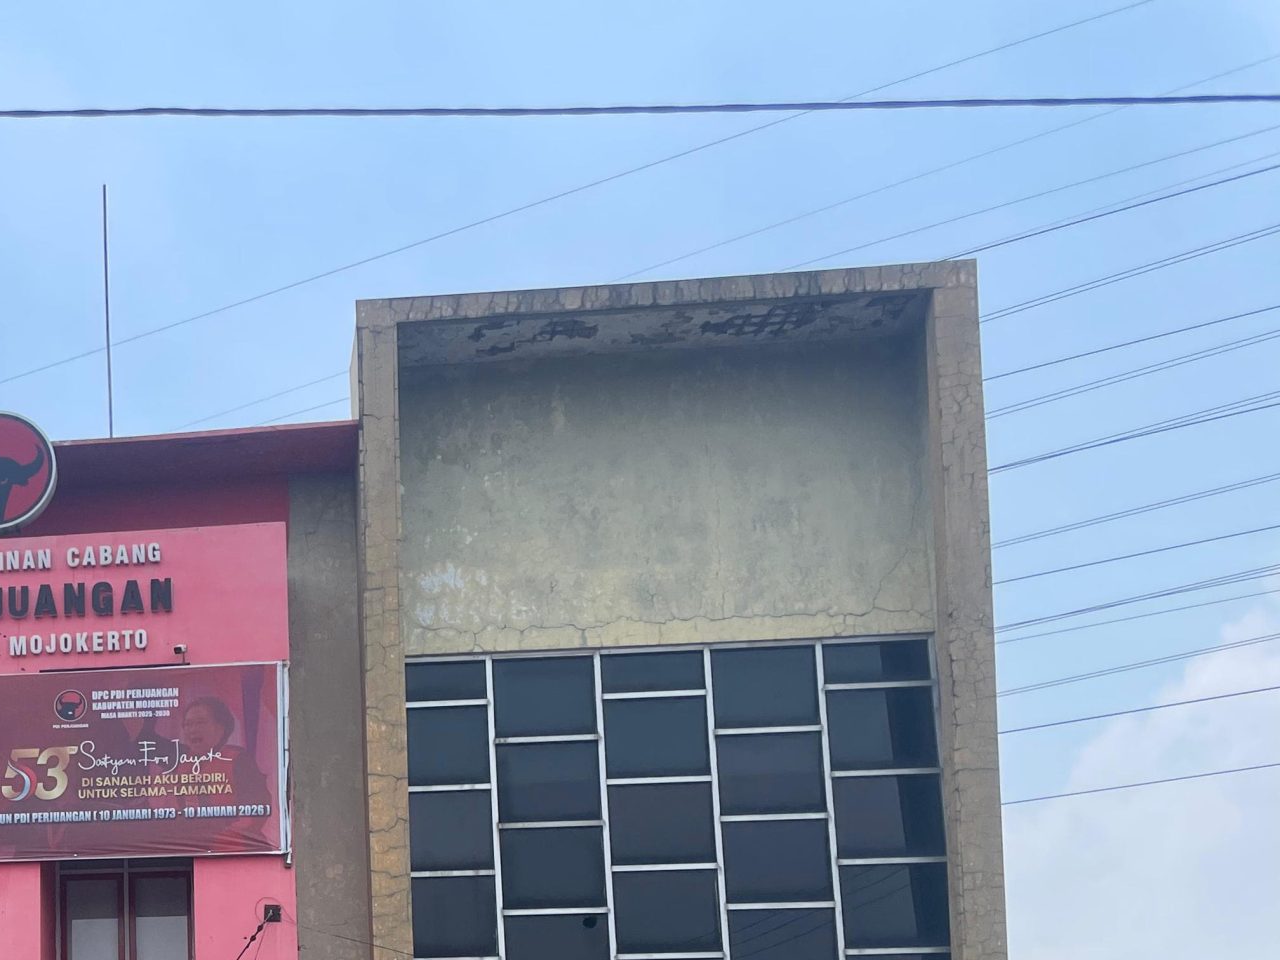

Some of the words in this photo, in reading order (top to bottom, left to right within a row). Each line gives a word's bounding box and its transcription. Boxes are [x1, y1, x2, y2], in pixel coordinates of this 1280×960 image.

[66, 543, 161, 568] CABANG
[9, 629, 148, 657] MOJOKERTO
[92, 690, 109, 700] DPC
[110, 689, 125, 700] PDI
[126, 688, 179, 699] PERJUANGAN
[92, 700, 135, 711] KABUPATEN
[135, 699, 179, 709] MOJOKERTO
[1, 746, 78, 801] 53
[81, 777, 94, 787] DI
[95, 775, 151, 787] SANALAH
[153, 774, 179, 785] AKU
[181, 773, 229, 784] BERDIRI,
[78, 788, 118, 799] UNTUK
[120, 784, 233, 797] SELAMA-LAMANYA
[14, 812, 30, 824] PDI
[32, 810, 92, 823] PERJUANGAN
[99, 809, 111, 821] 10
[112, 808, 152, 820] JANUARI
[153, 808, 176, 819] 1973
[183, 806, 195, 818] 10
[196, 806, 237, 818] JANUARI
[238, 804, 264, 817] 2026
